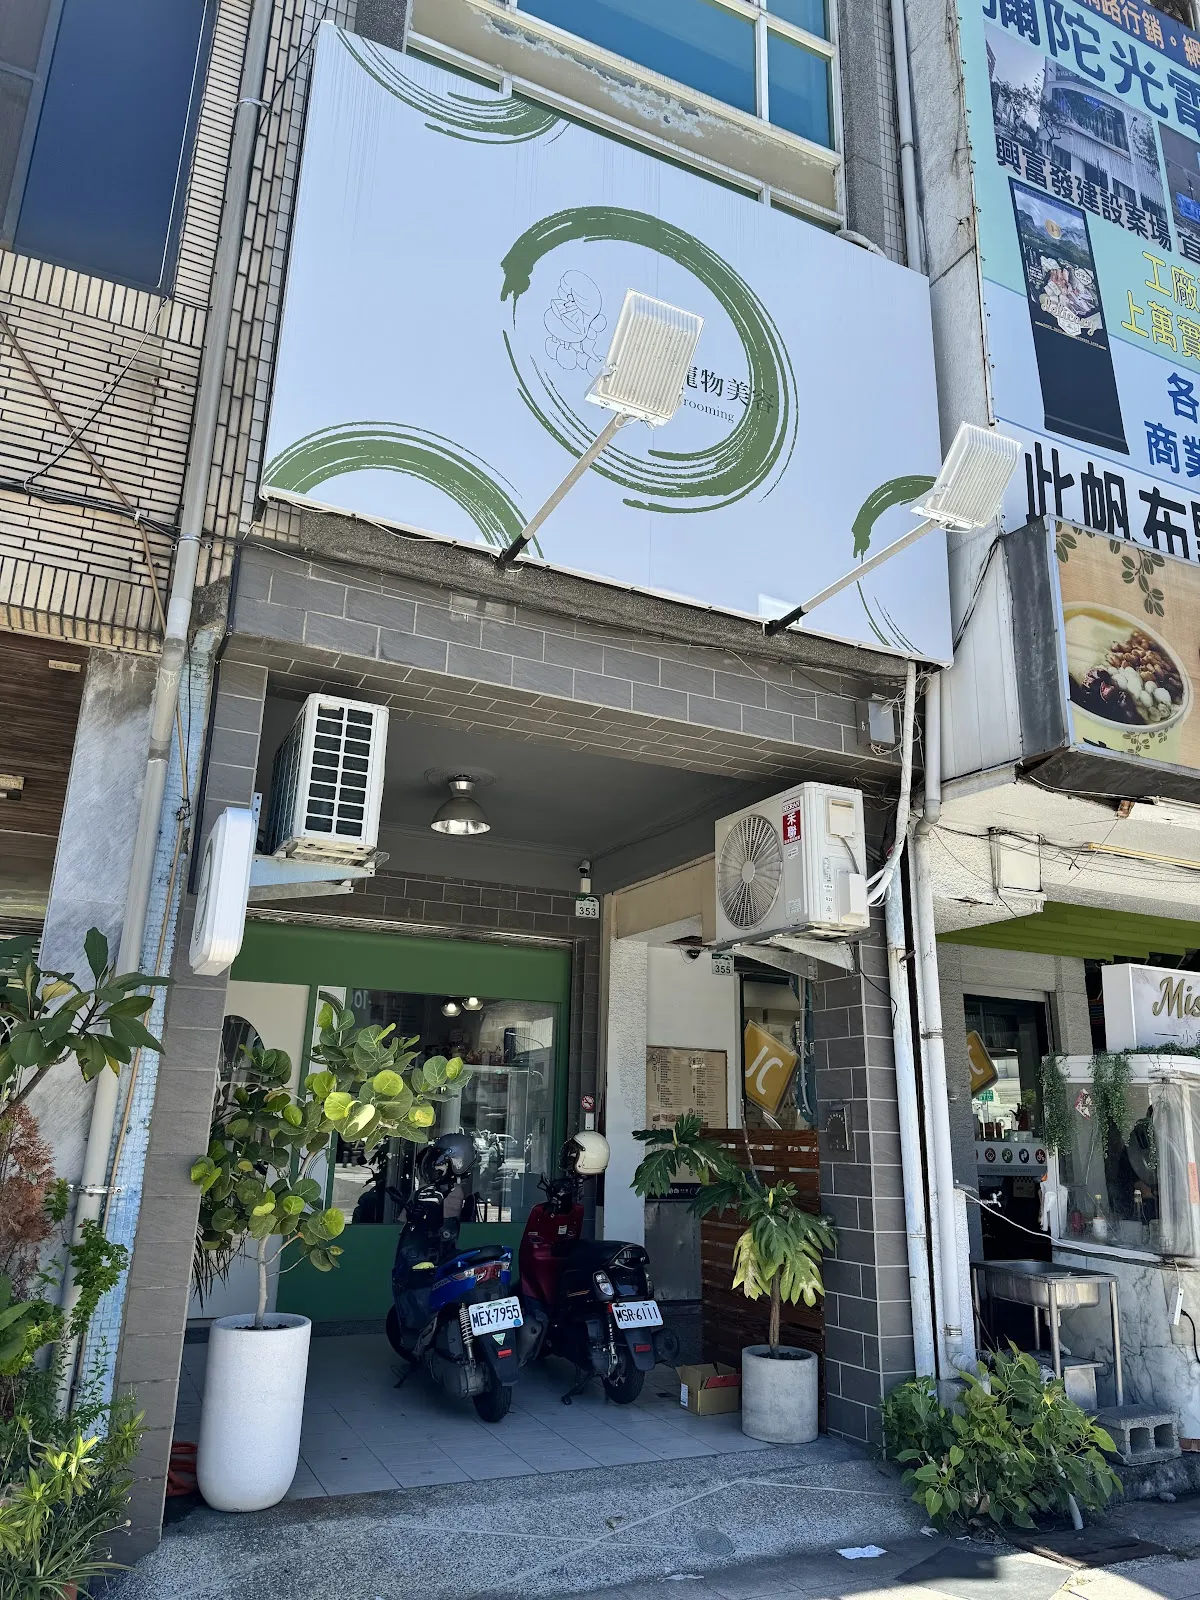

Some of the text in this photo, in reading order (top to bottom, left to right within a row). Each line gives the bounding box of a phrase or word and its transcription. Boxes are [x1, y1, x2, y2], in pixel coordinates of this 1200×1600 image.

[996, 136, 1171, 252] 興富發建設案場
[1141, 251, 1200, 313] 工廠
[683, 398, 734, 424] rooming
[1166, 372, 1200, 425] 各
[1025, 441, 1200, 561] 此帆布
[579, 906, 597, 917] 353
[715, 964, 731, 974] 355
[471, 1304, 520, 1329] MEX-7955
